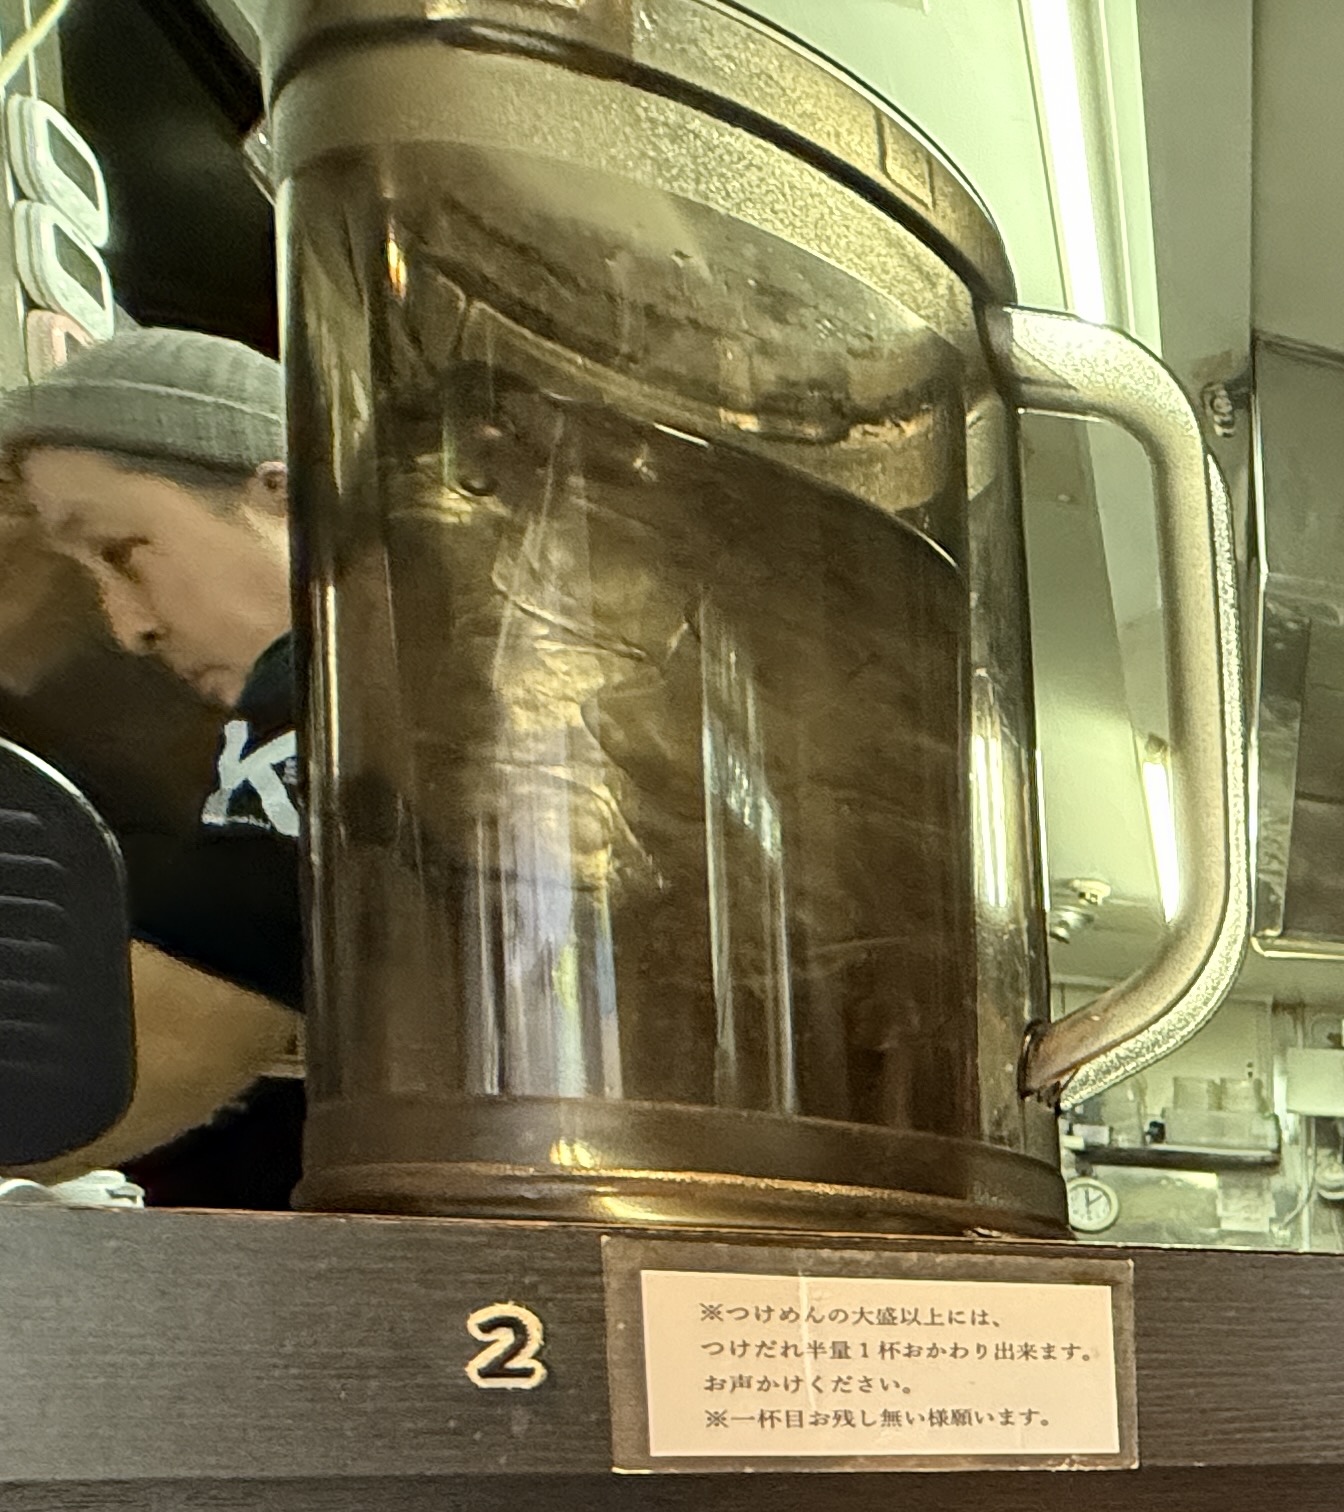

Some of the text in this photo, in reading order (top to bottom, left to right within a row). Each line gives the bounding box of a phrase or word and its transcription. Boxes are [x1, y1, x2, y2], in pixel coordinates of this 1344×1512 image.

[464, 1301, 548, 1391] 2
[705, 1373, 913, 1396] お声かけください。
